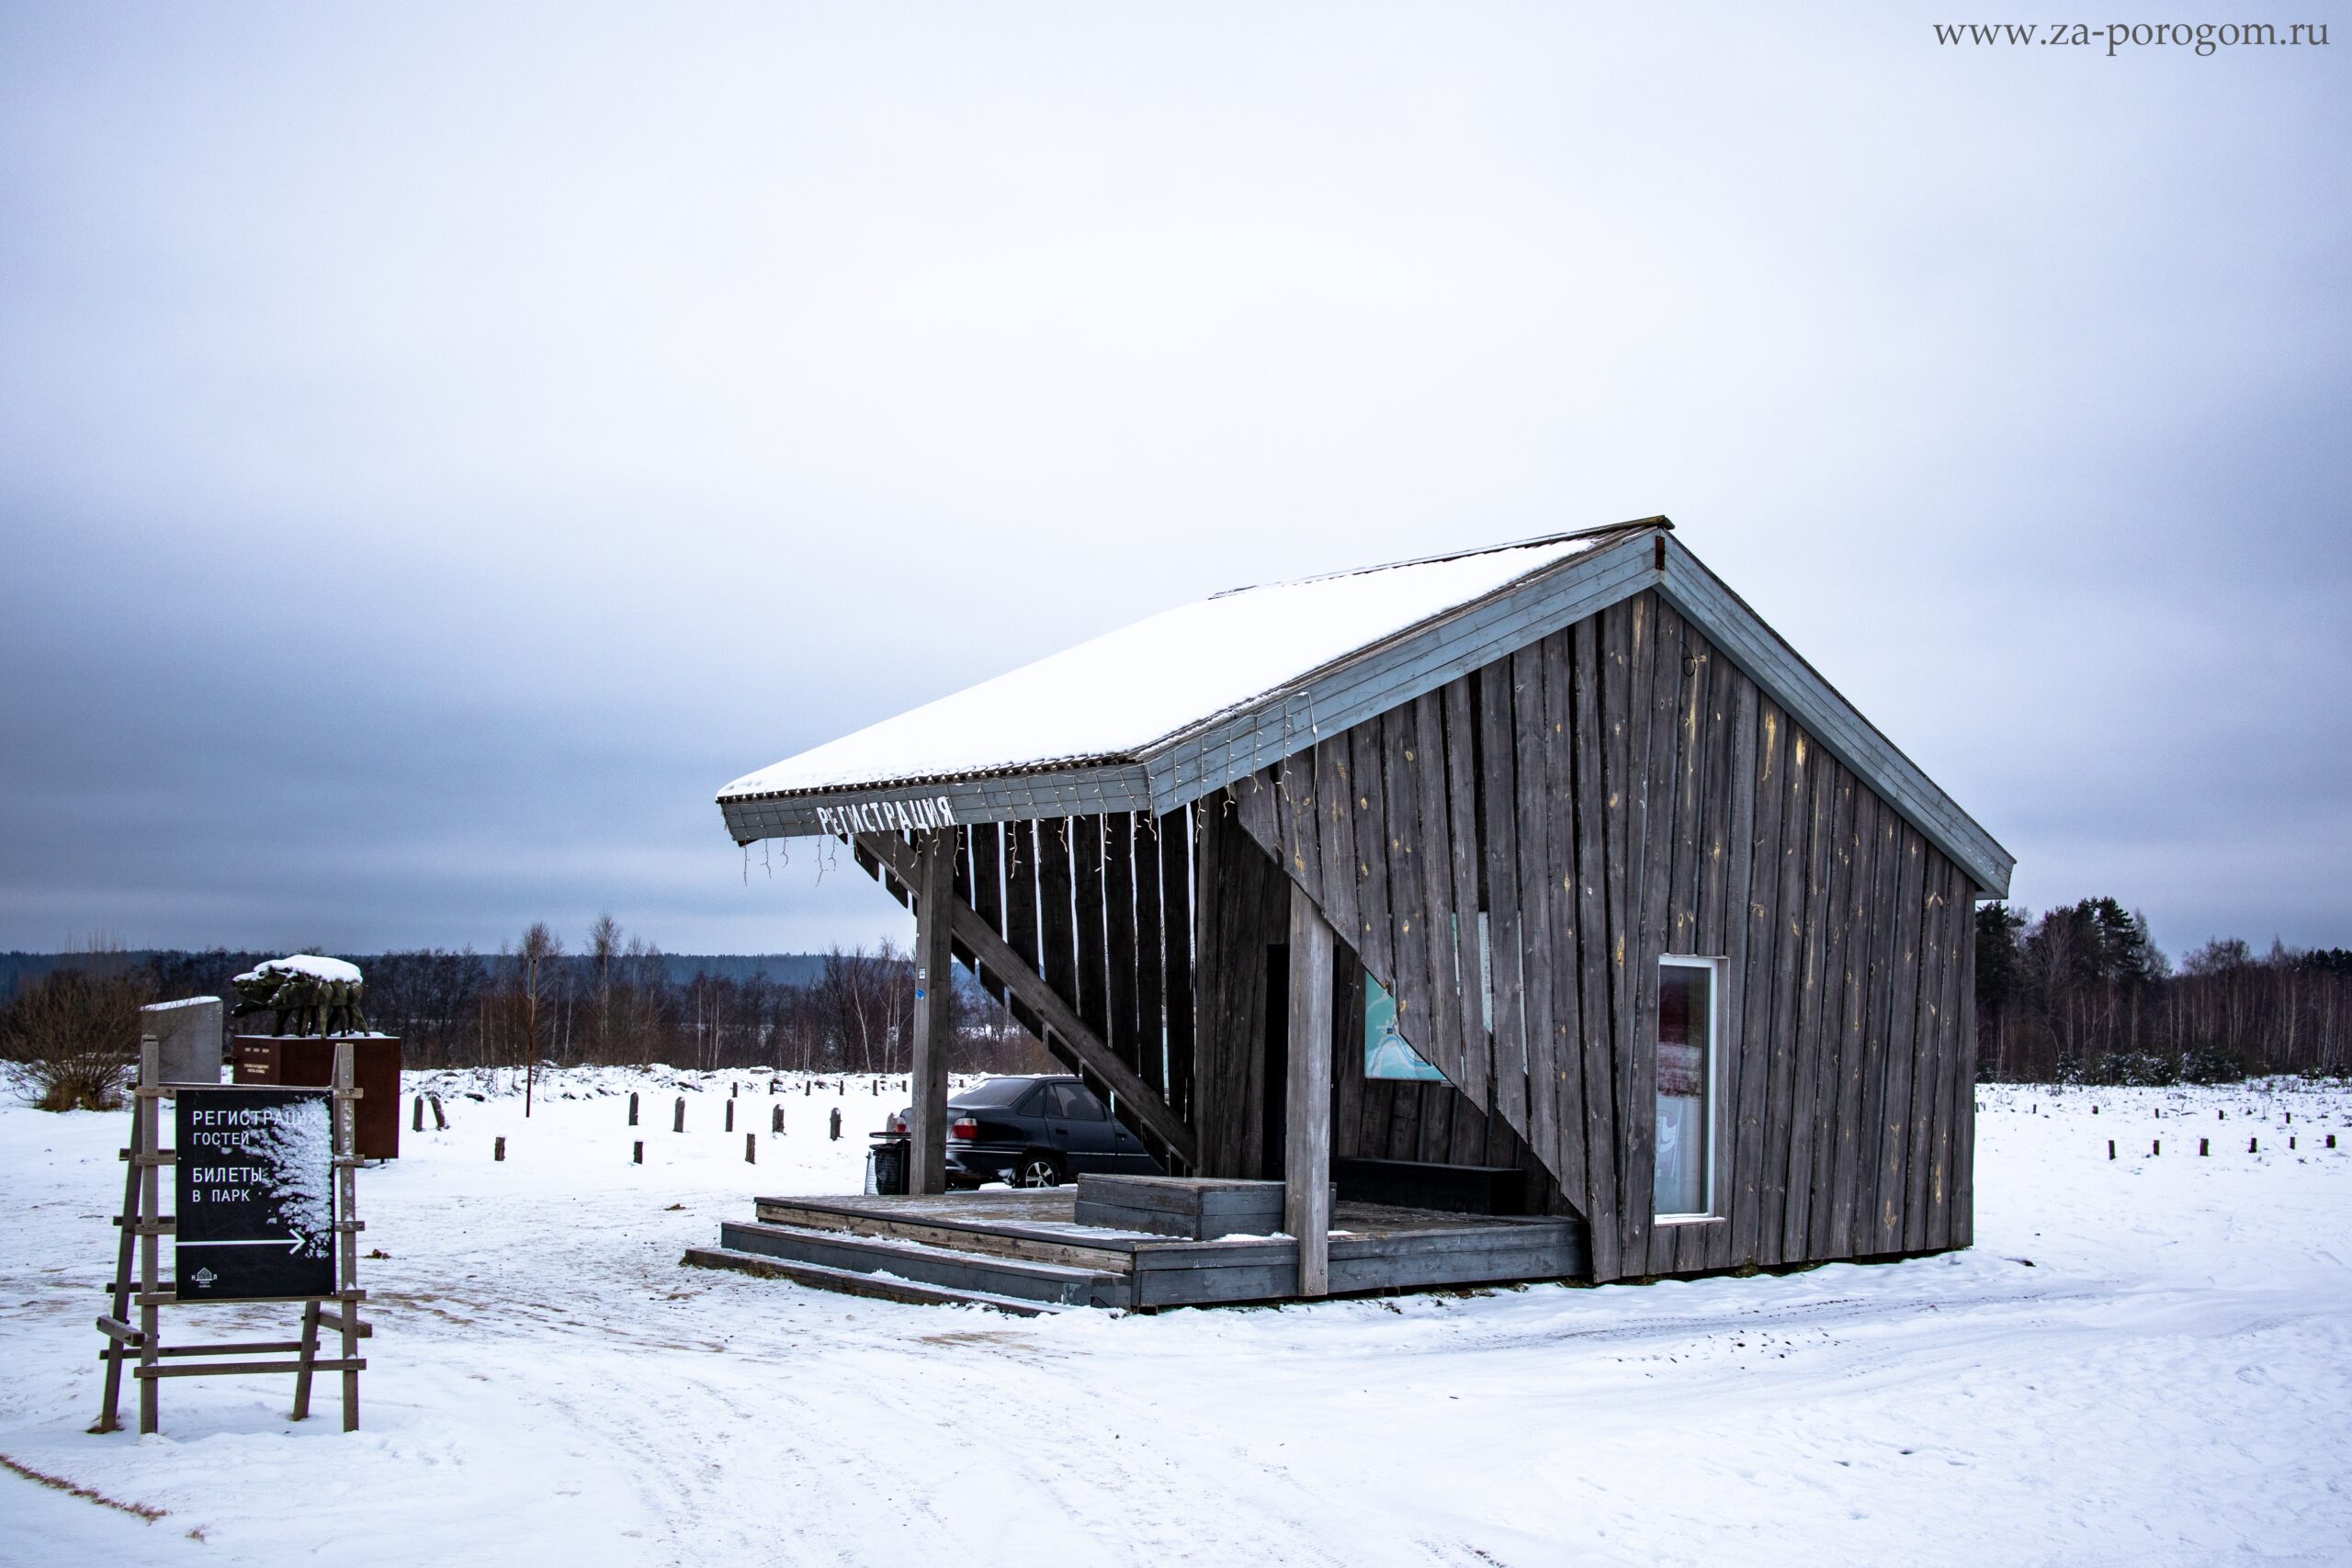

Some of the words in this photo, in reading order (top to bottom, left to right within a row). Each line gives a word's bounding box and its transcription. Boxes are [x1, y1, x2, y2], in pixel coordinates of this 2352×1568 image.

[816, 795, 957, 836] РЕГИСТРАЦИЯ
[193, 1130, 250, 1145] ГОСТЕЙ
[192, 1167, 262, 1182] БИЛЕТЫ
[192, 1189, 201, 1202] В
[211, 1189, 251, 1202] ПАРК
